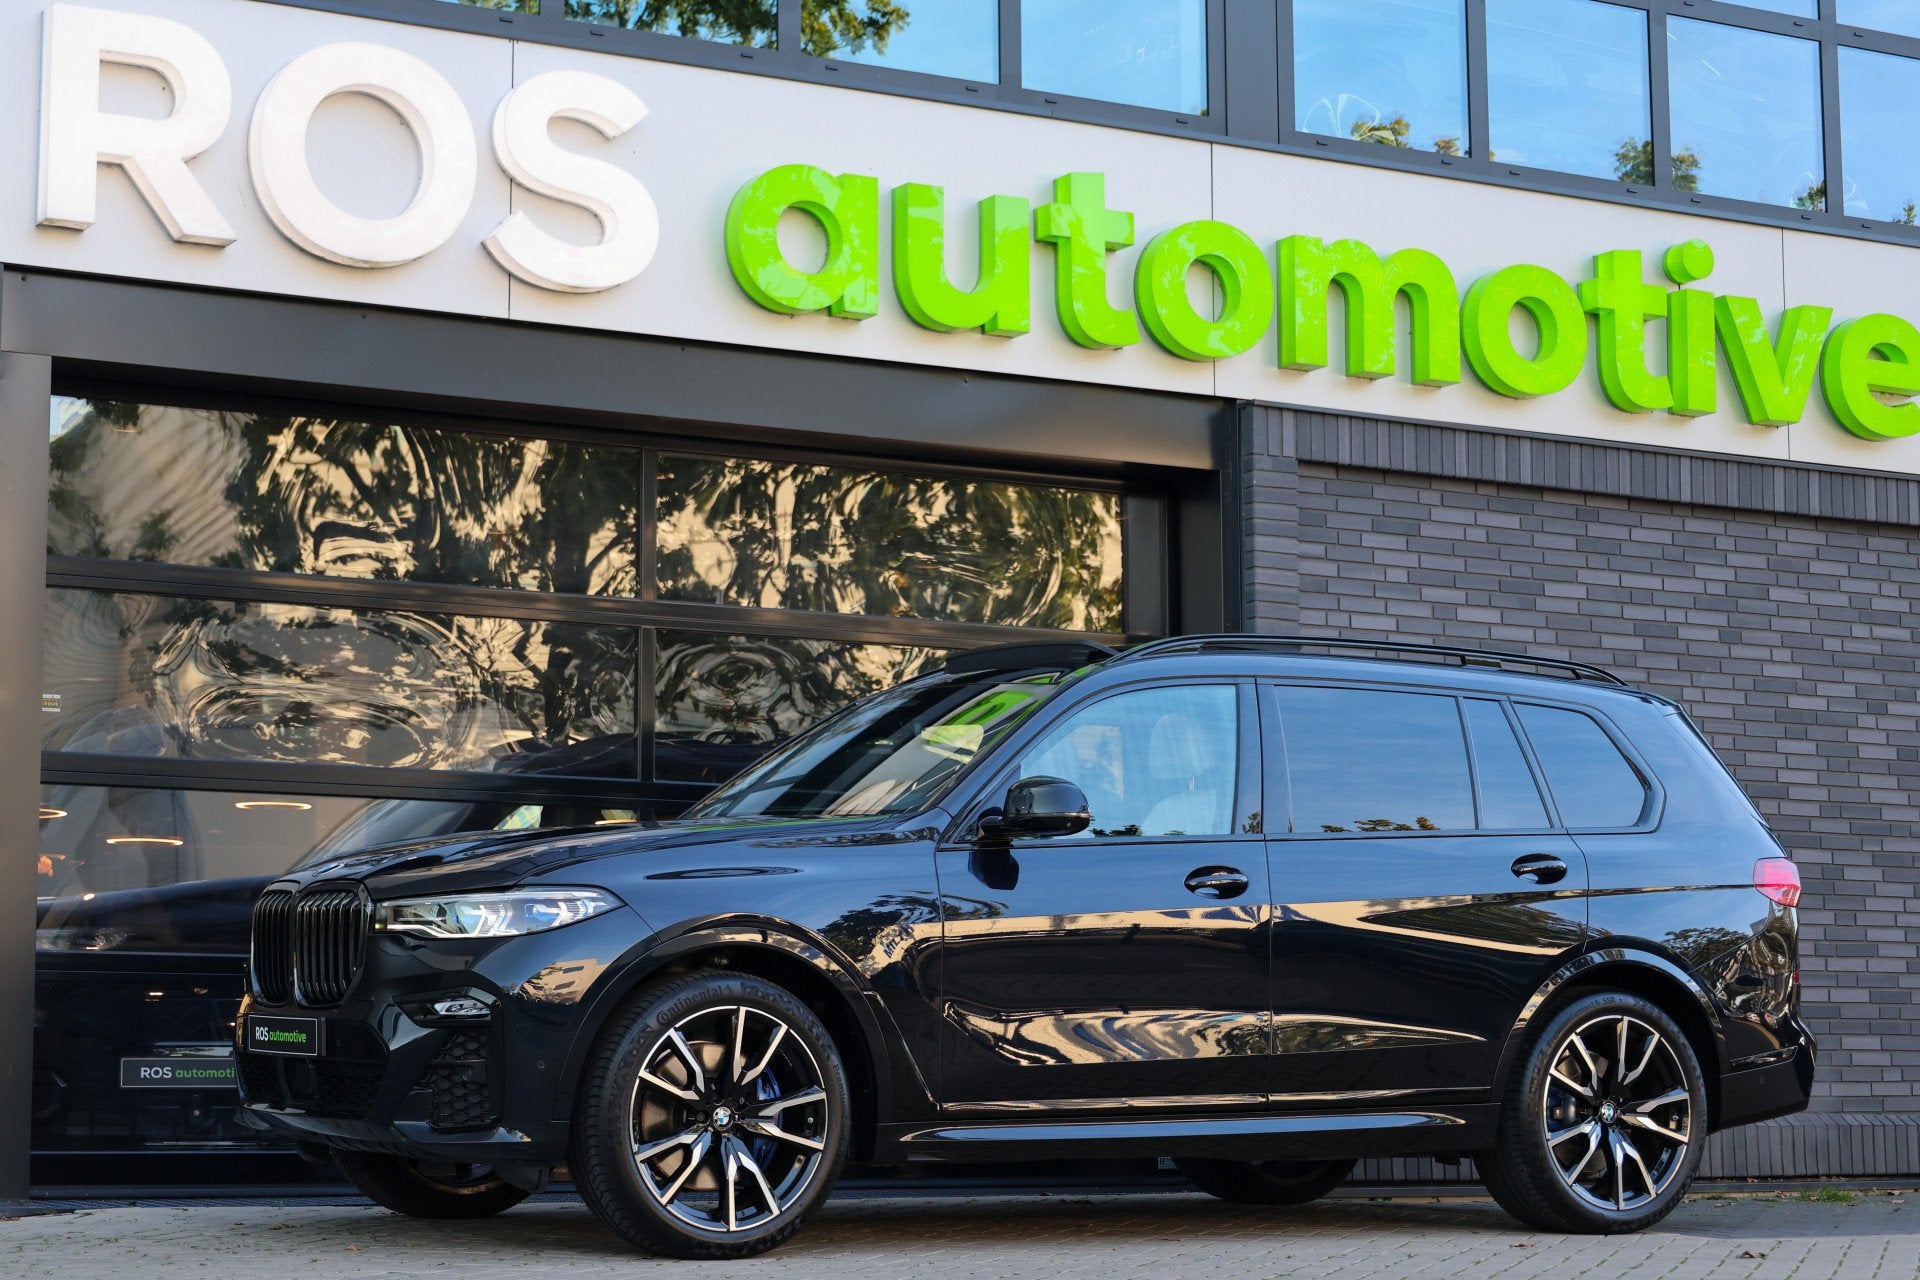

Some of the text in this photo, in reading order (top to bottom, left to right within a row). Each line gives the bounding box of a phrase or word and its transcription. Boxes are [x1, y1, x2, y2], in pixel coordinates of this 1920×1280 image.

[35, 2, 1920, 442] ROS automotive
[656, 985, 722, 1025] Continental
[255, 1026, 307, 1044] ROS automotive
[140, 1066, 235, 1079] ROS automoti
